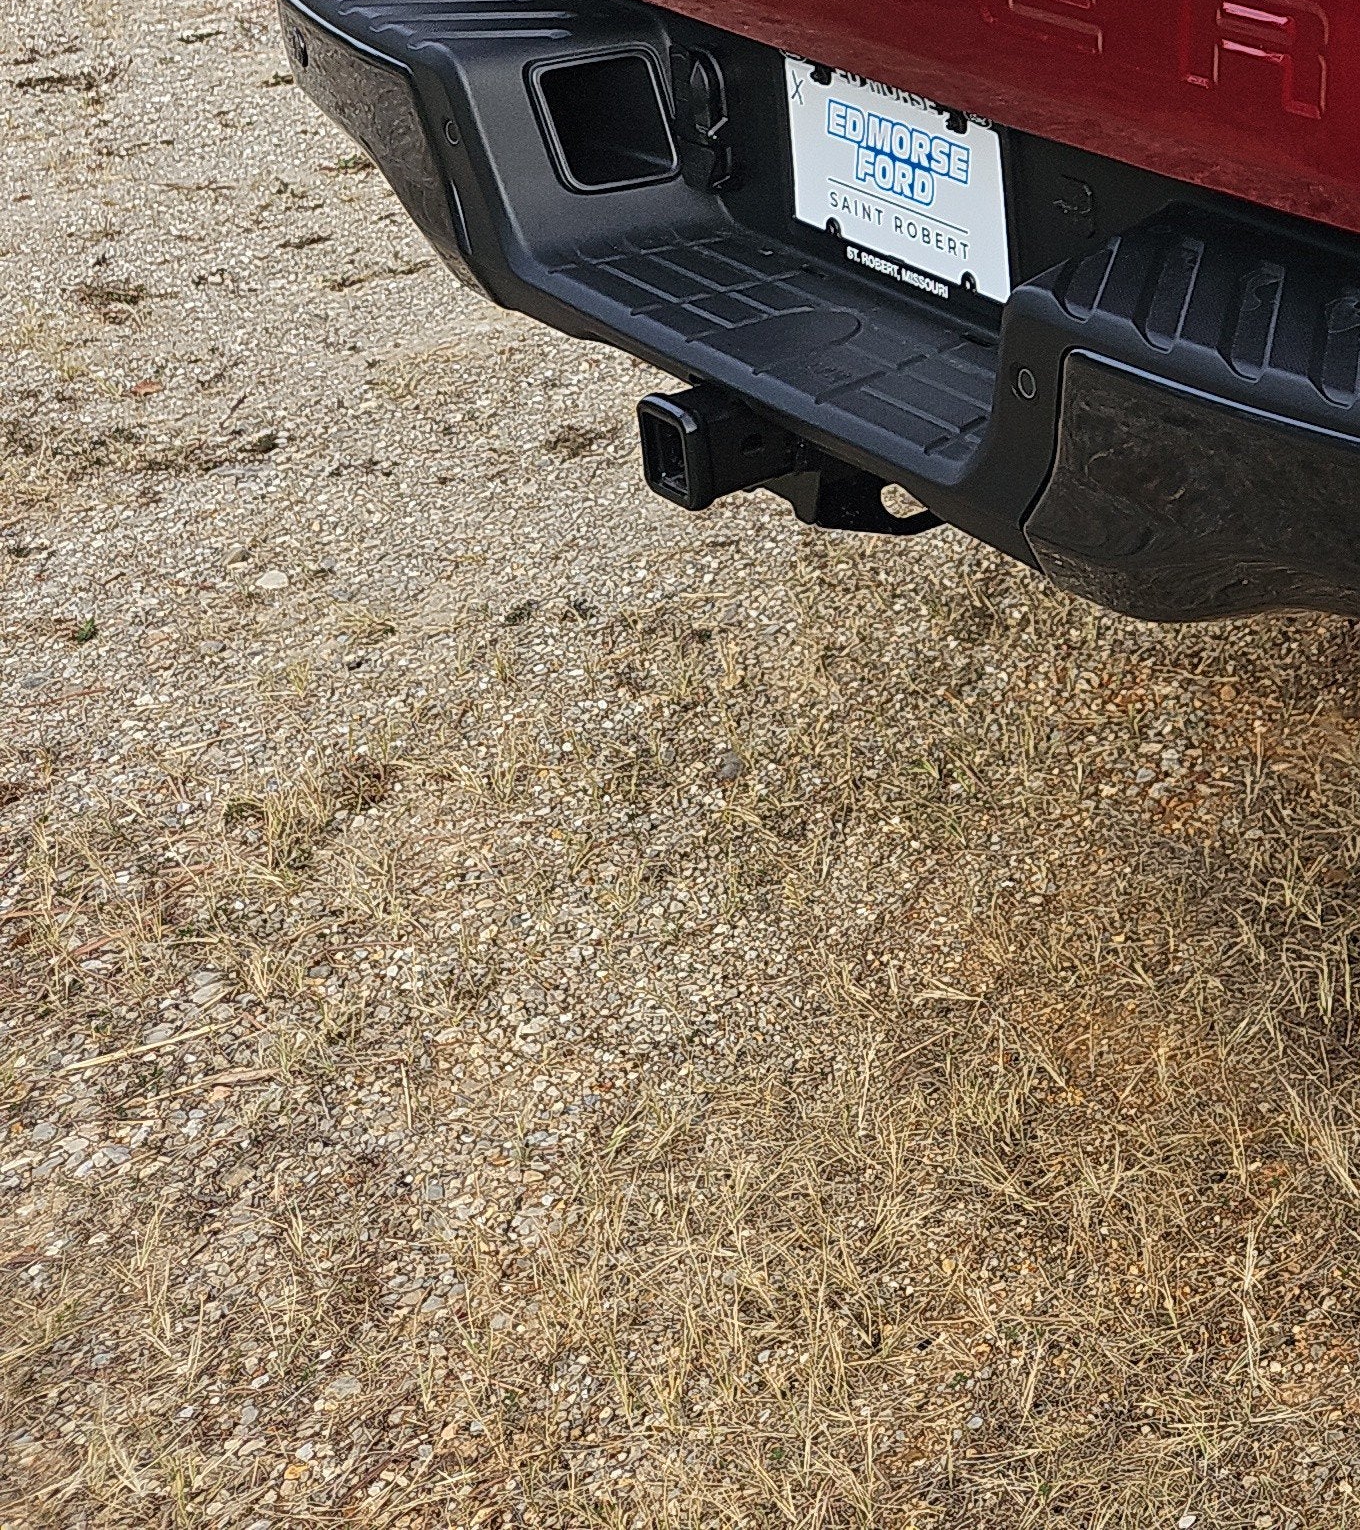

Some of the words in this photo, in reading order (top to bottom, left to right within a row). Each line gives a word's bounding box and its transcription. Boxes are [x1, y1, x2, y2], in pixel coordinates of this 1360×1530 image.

[827, 98, 867, 146] ED
[866, 112, 971, 184] MORSE
[855, 147, 935, 207] FORD
[829, 191, 884, 226] SAINT
[894, 215, 970, 261] ROBERT
[901, 267, 949, 299] MISSOURI
